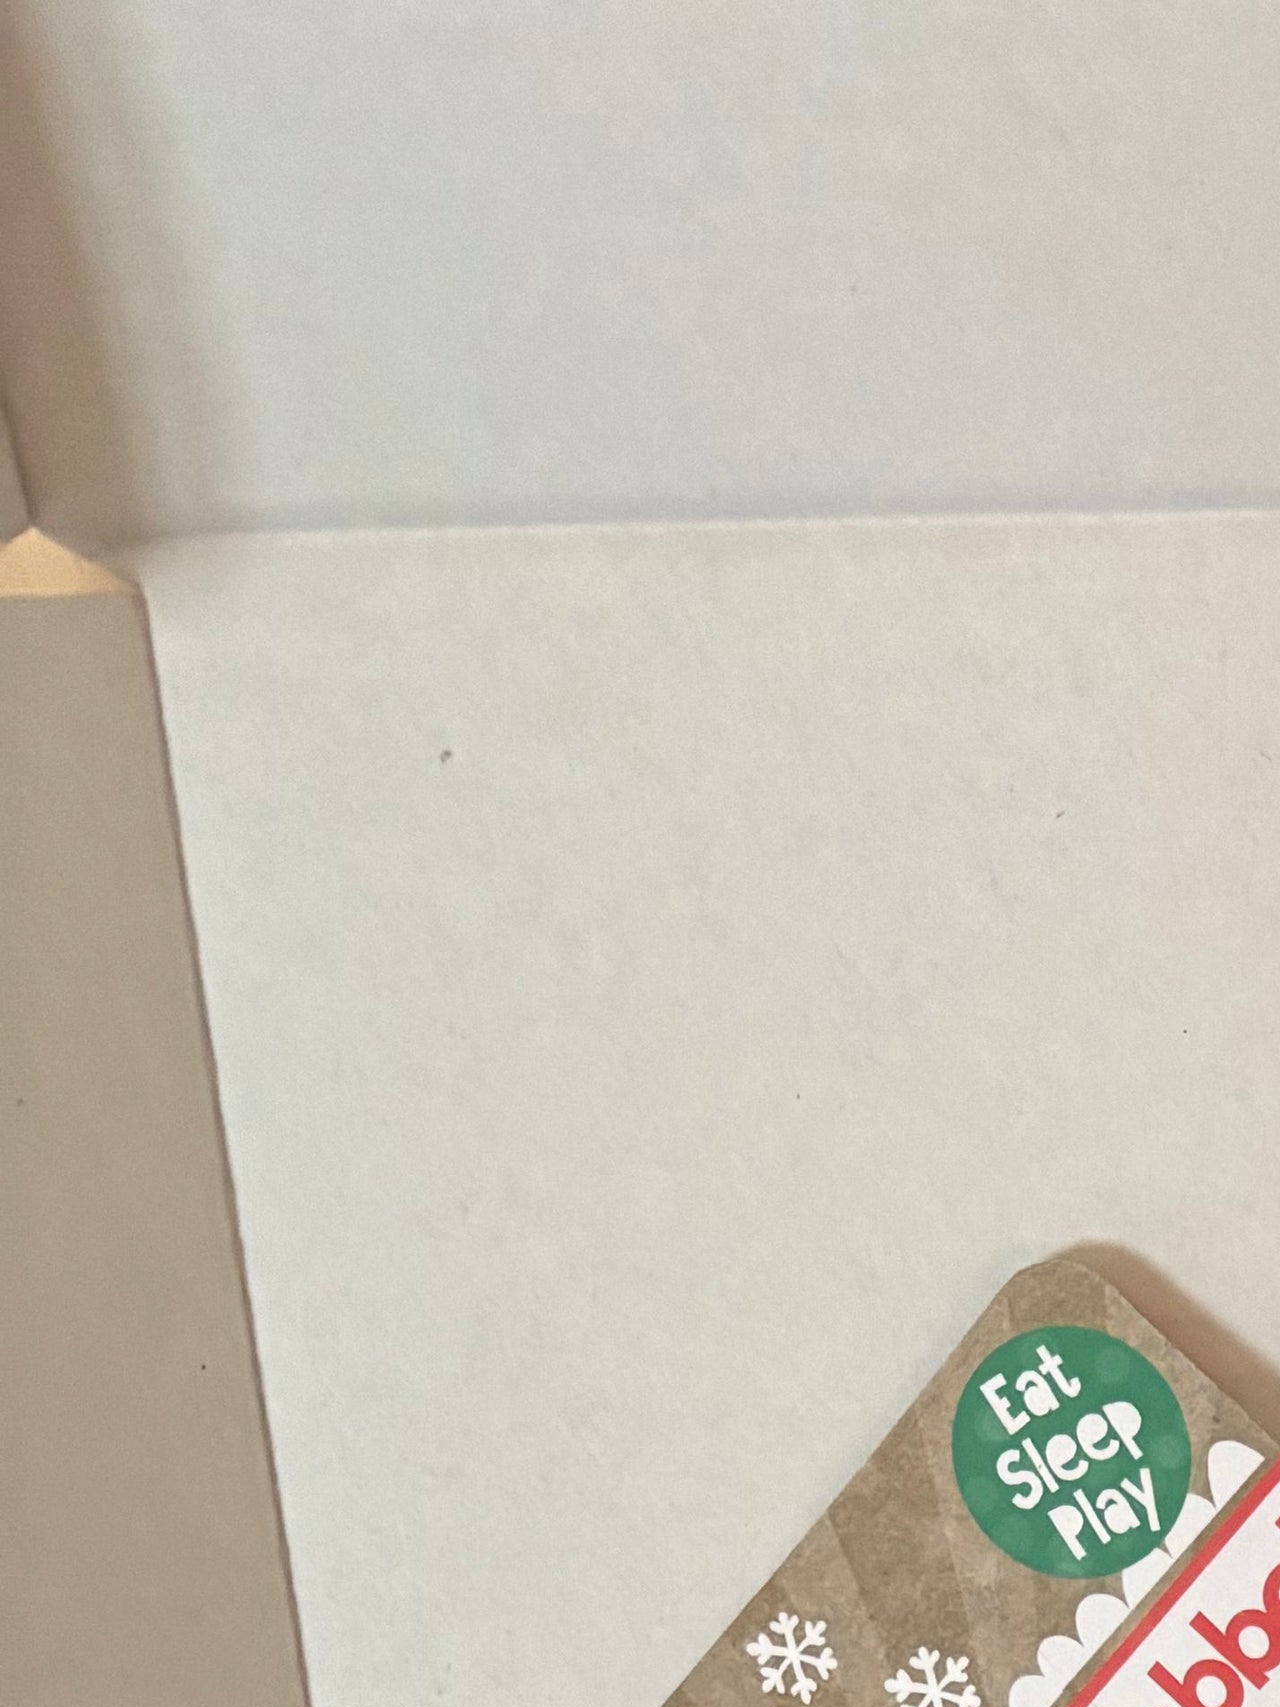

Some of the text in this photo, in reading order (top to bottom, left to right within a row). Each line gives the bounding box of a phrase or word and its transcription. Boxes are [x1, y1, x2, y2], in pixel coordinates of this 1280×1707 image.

[980, 1345, 1081, 1435] Eat
[996, 1401, 1143, 1510] Sleep
[1047, 1468, 1160, 1561] Play
